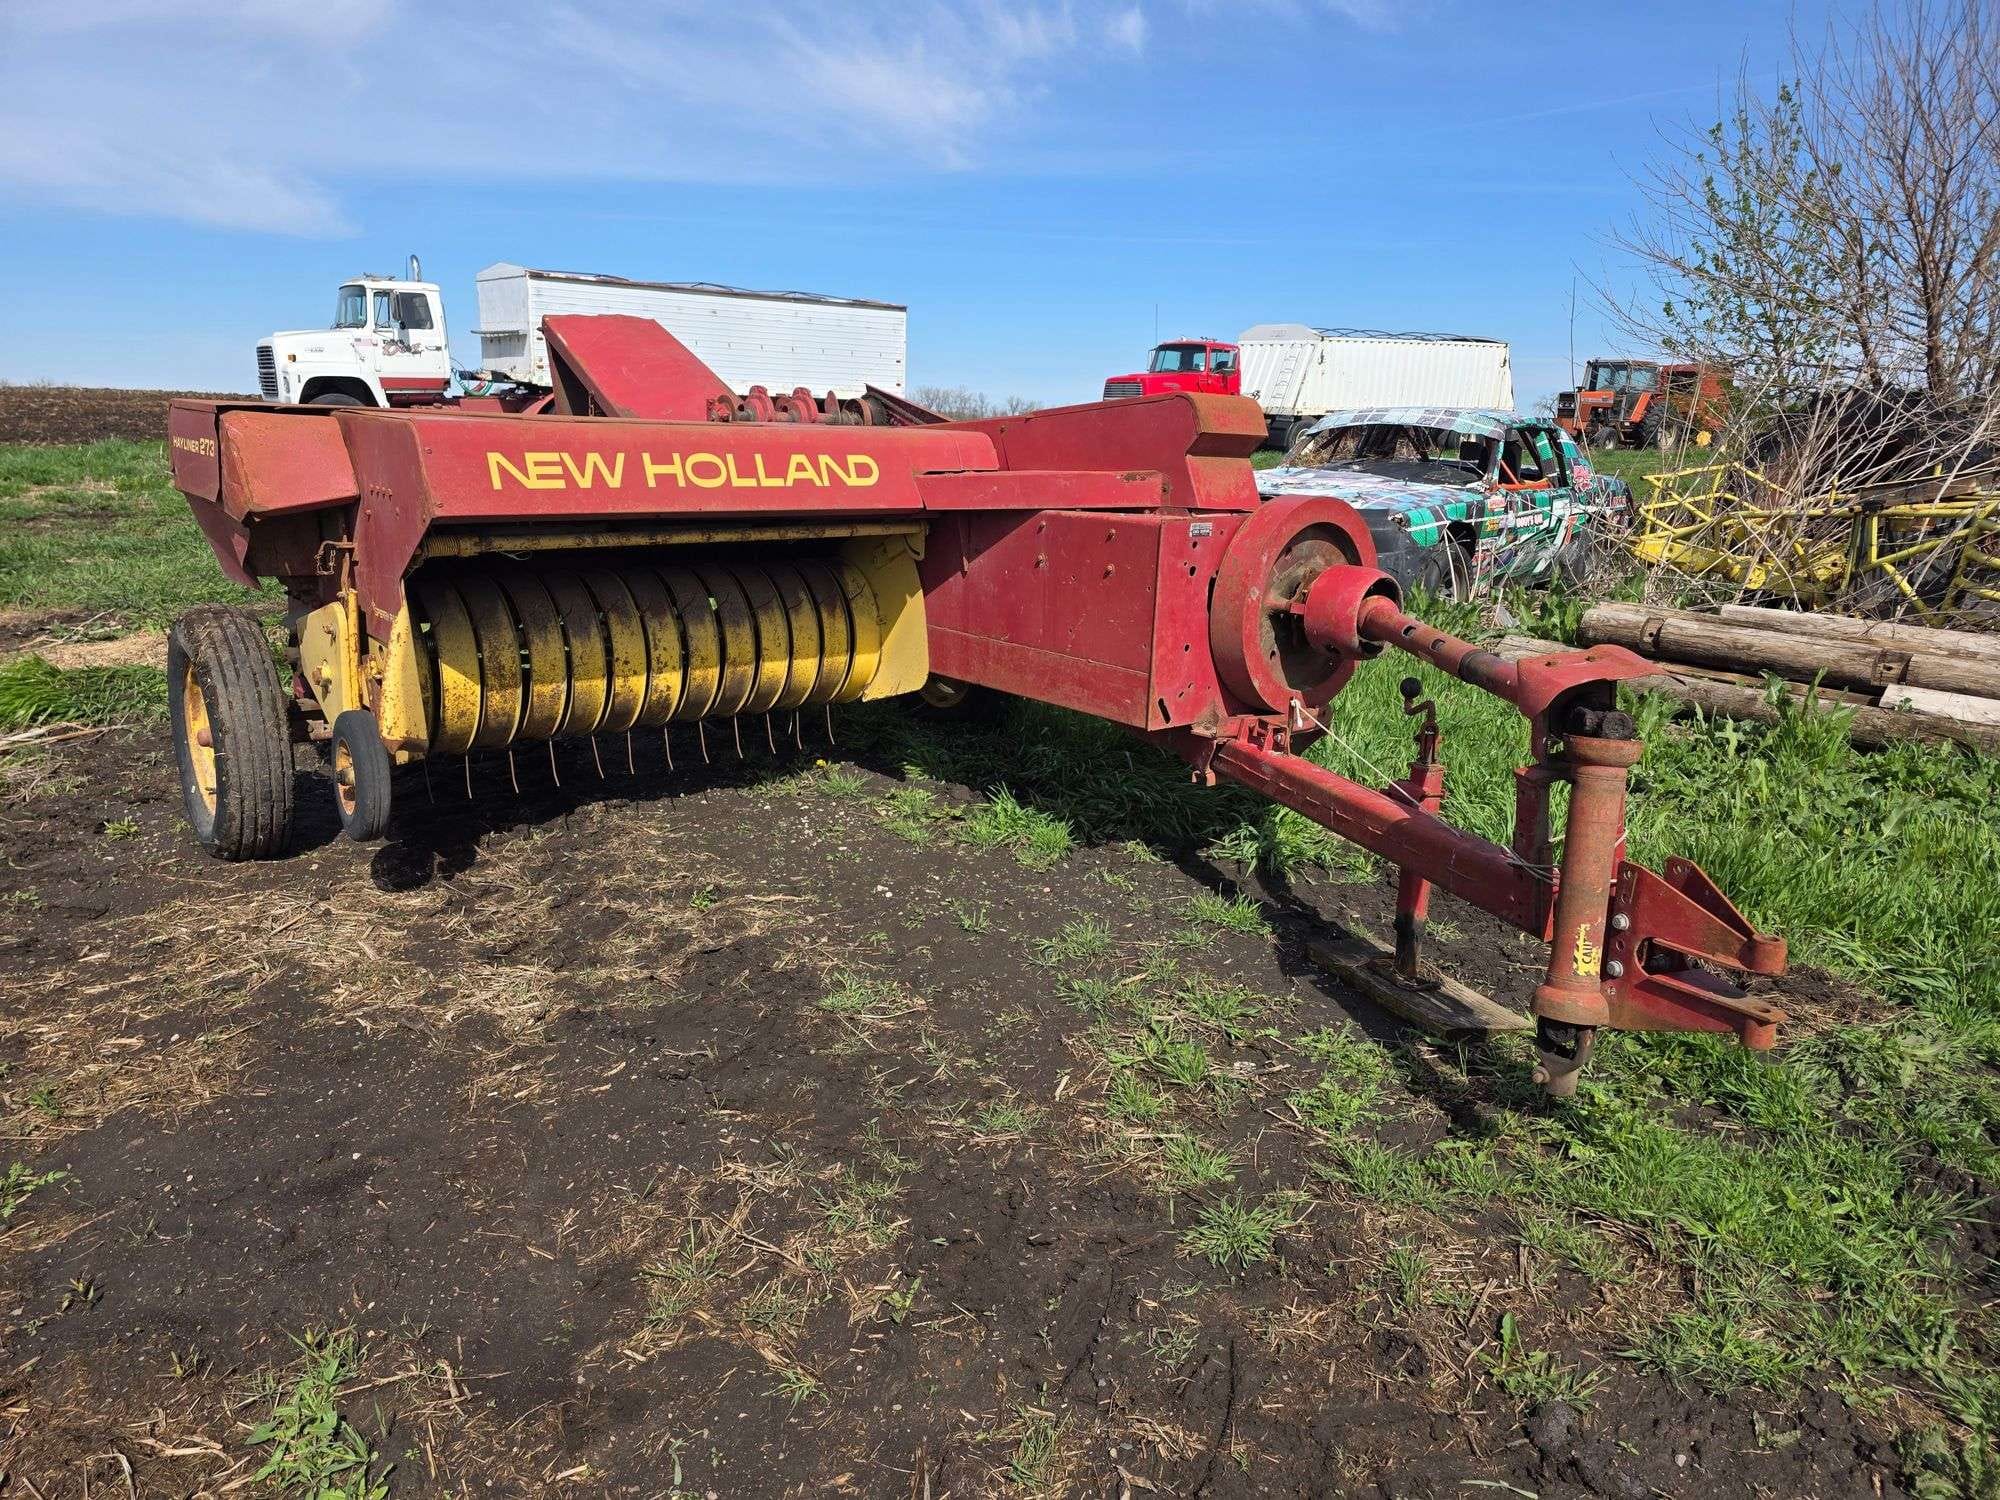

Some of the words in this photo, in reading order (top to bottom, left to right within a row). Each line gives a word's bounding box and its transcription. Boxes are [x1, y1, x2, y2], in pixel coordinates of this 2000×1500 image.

[172, 435, 200, 454] HAYLINER
[200, 437, 215, 457] 273
[486, 452, 625, 490] NEW
[641, 452, 880, 488] HOLLAND
